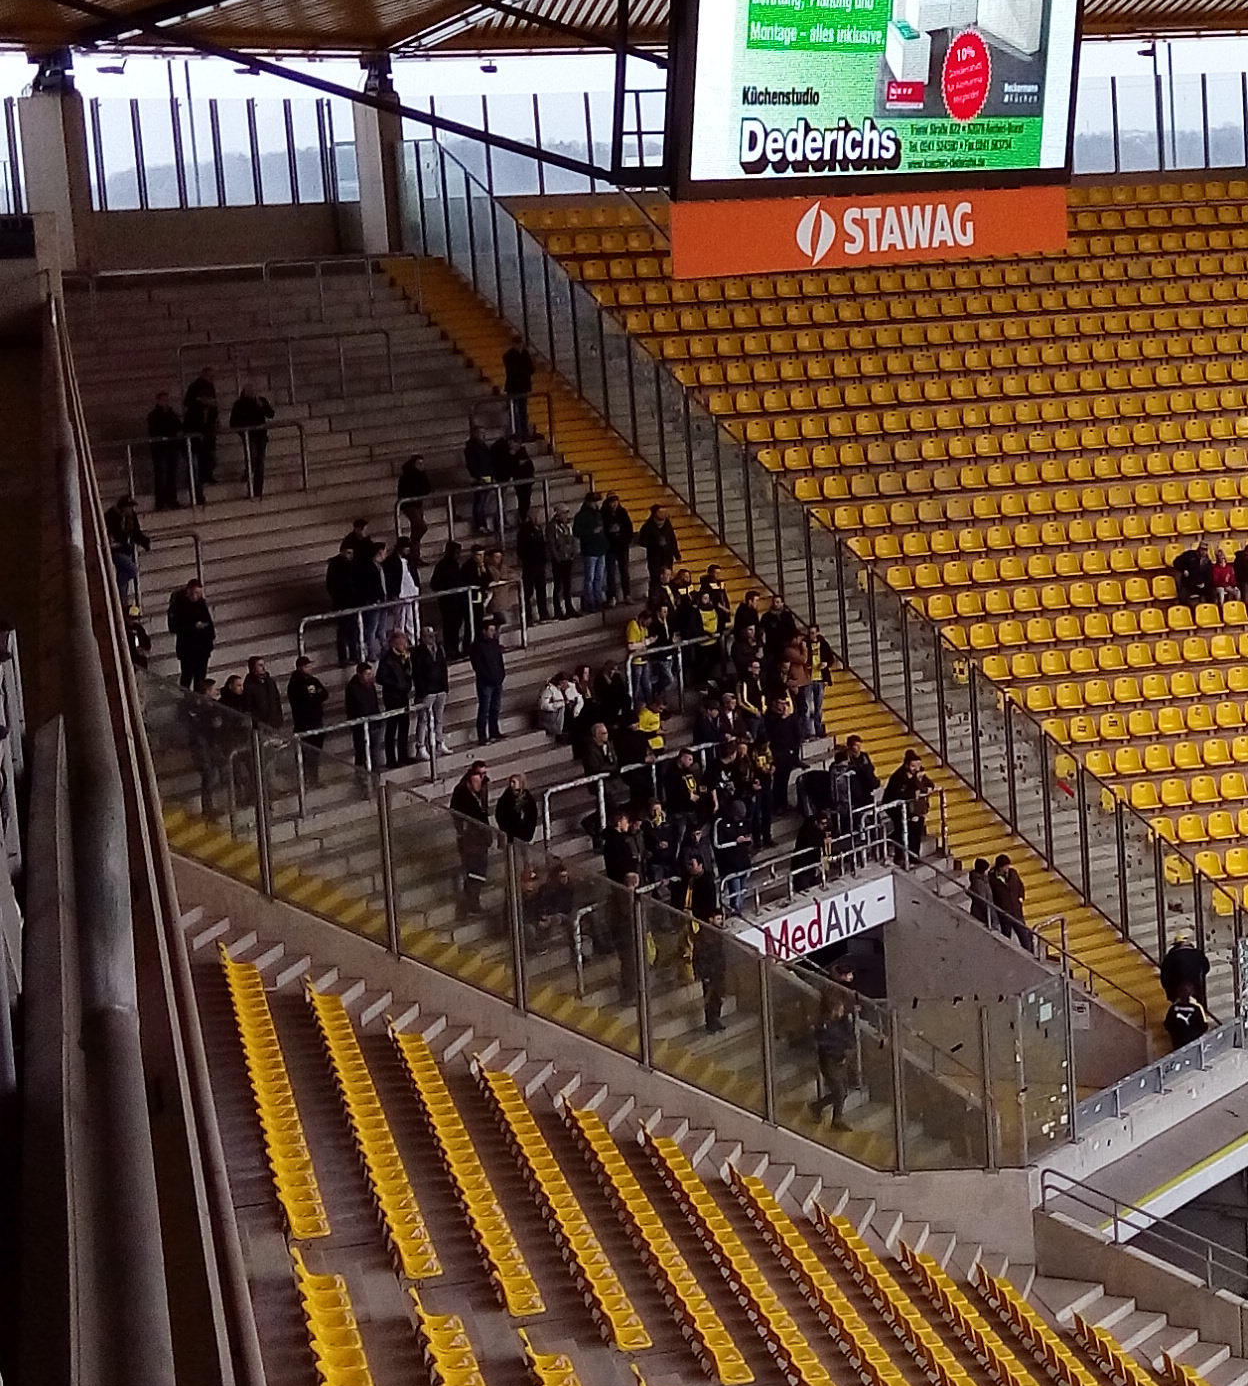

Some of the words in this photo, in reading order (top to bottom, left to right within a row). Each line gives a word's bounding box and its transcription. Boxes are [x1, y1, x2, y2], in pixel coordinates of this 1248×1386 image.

[750, 21, 797, 45] Montage
[809, 23, 834, 43] alles
[836, 24, 885, 45] inklusive.
[956, 46, 976, 62] 10%
[742, 86, 820, 106] Küchenstudio
[740, 117, 899, 168] Dederichs
[843, 202, 975, 255] STAWAG
[763, 892, 867, 960] MedAix
